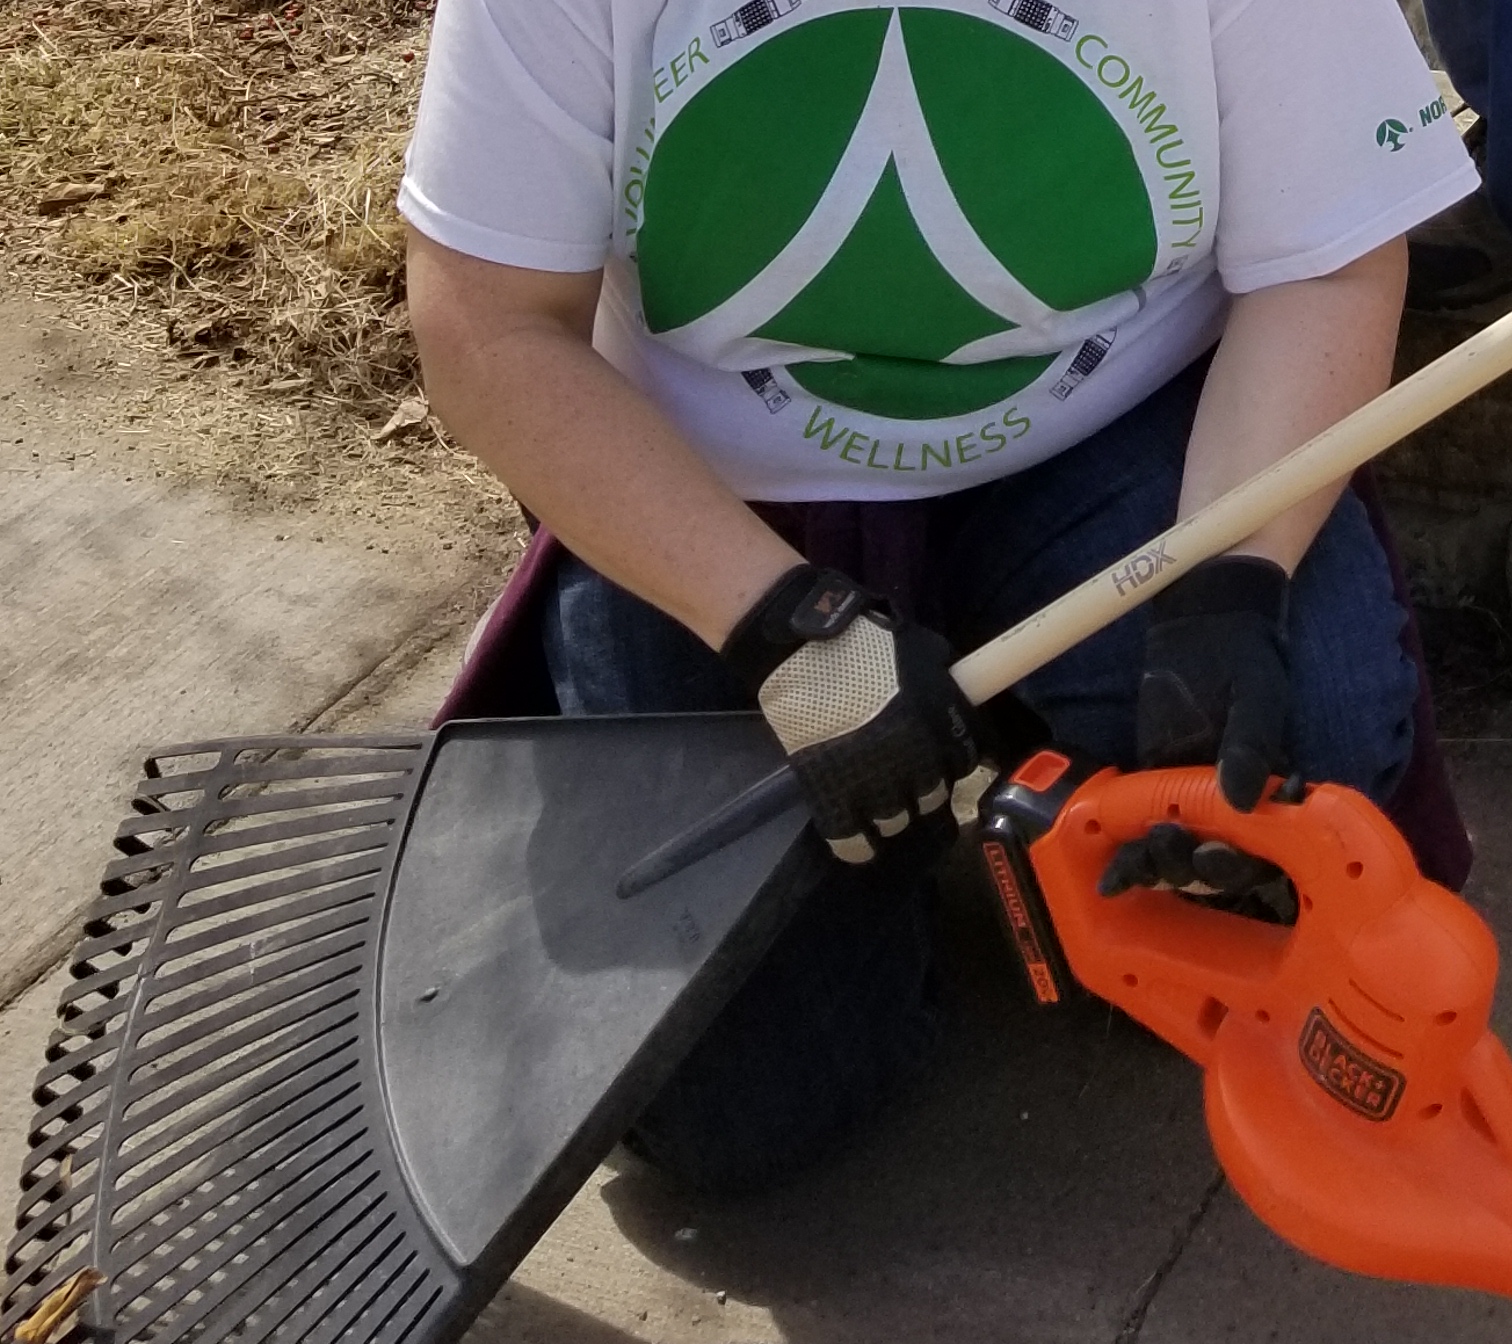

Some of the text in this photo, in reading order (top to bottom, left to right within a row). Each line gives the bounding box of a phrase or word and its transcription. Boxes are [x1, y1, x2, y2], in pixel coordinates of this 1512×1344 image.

[1075, 32, 1203, 251] COMMUNITY
[802, 403, 1032, 473] WELLNESS
[1111, 540, 1178, 598] HDX
